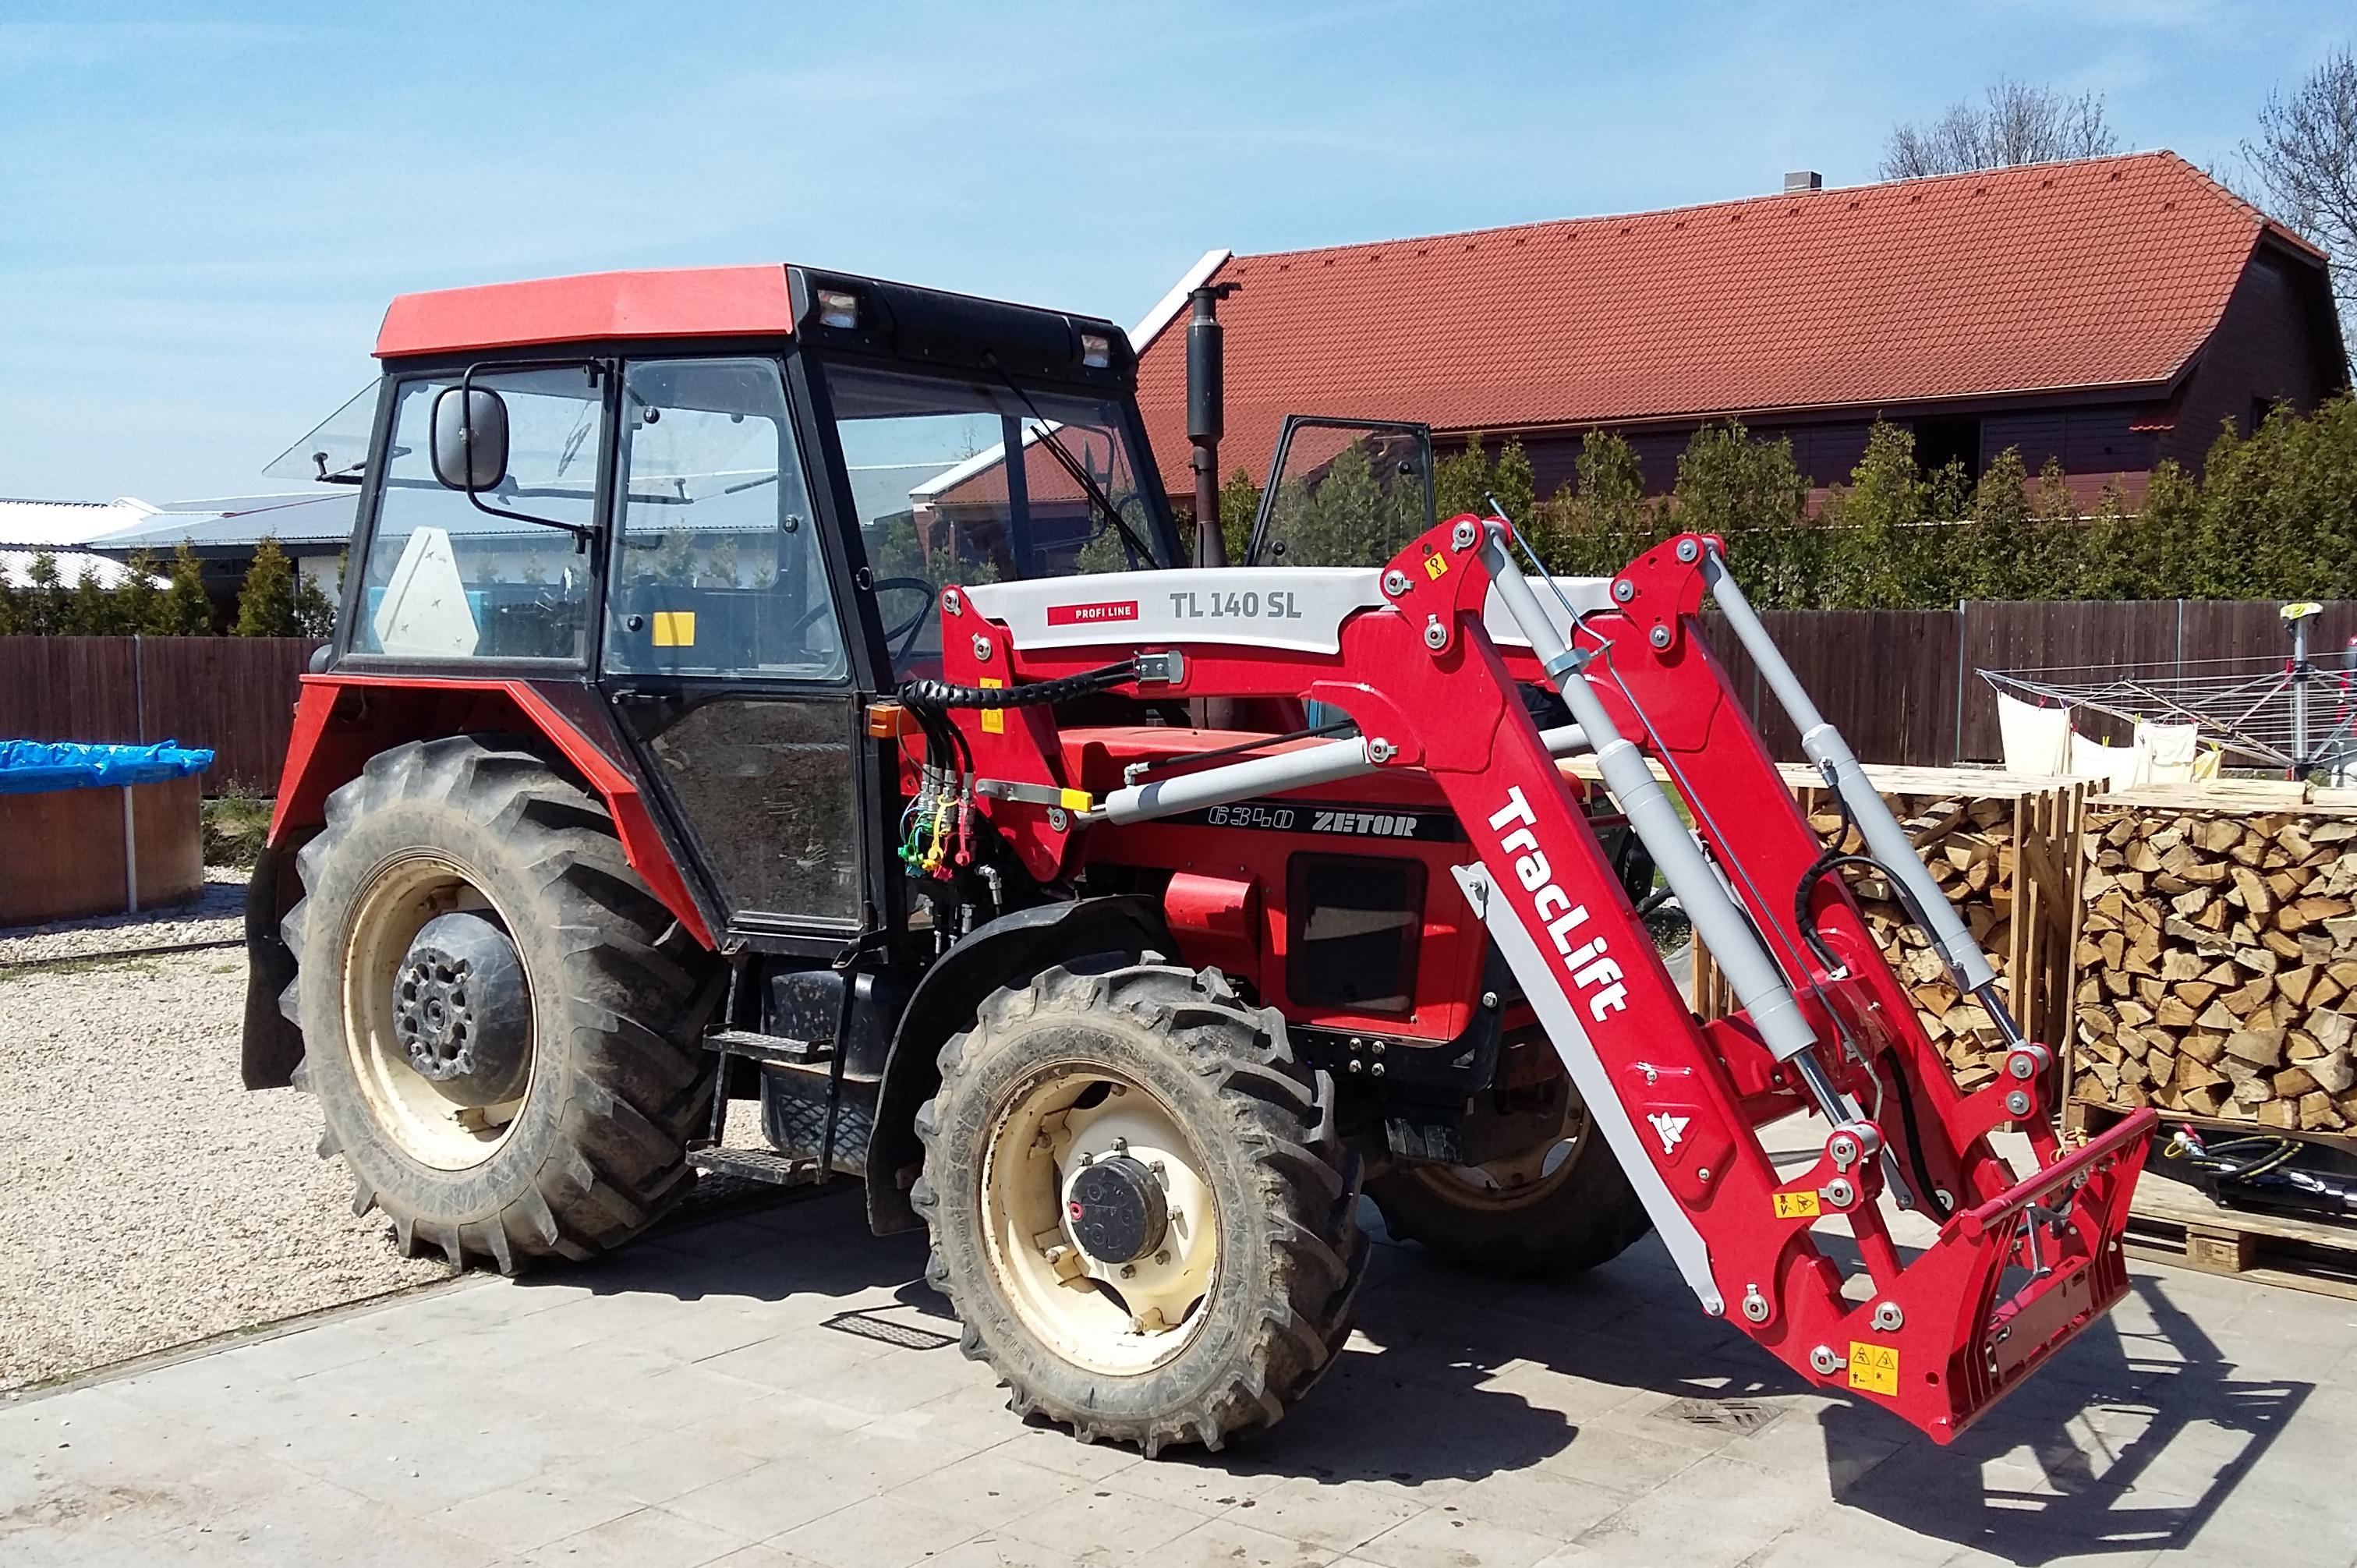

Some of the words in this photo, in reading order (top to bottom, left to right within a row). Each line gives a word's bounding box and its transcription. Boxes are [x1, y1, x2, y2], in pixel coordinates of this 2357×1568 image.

[1074, 608, 1105, 619] PROFI
[1108, 606, 1131, 617] LINE
[1170, 593, 1203, 618] TL
[1211, 591, 1259, 618] 140
[1268, 592, 1302, 618] SL
[1208, 805, 1294, 829] 6340
[1312, 811, 1417, 837] ZETOR
[1488, 784, 1629, 1022] TracLift
